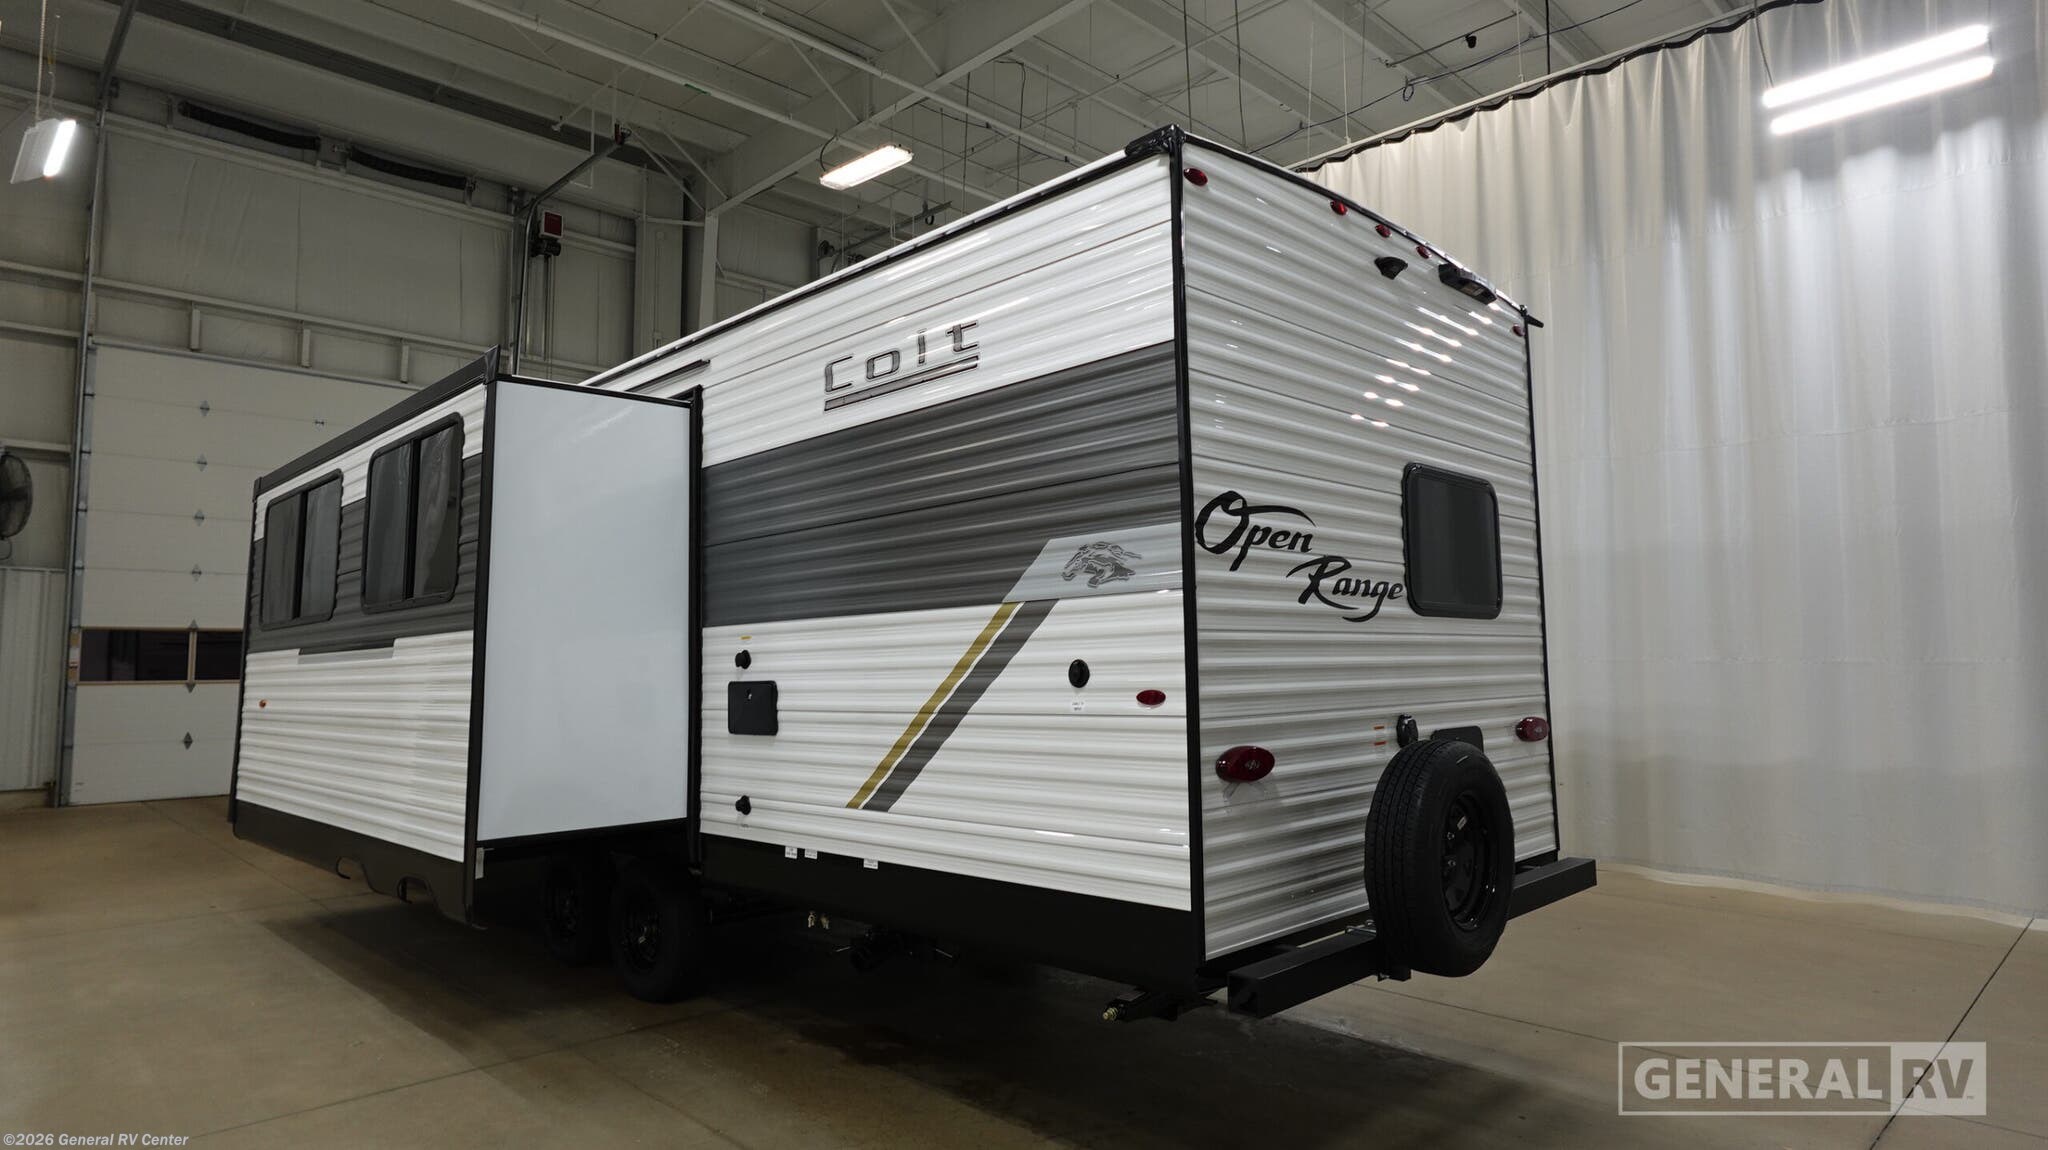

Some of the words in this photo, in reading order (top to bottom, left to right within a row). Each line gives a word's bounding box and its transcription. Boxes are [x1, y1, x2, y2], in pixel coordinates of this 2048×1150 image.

[825, 319, 979, 392] Colt
[1195, 491, 1316, 572] Open
[1286, 555, 1404, 622] Range
